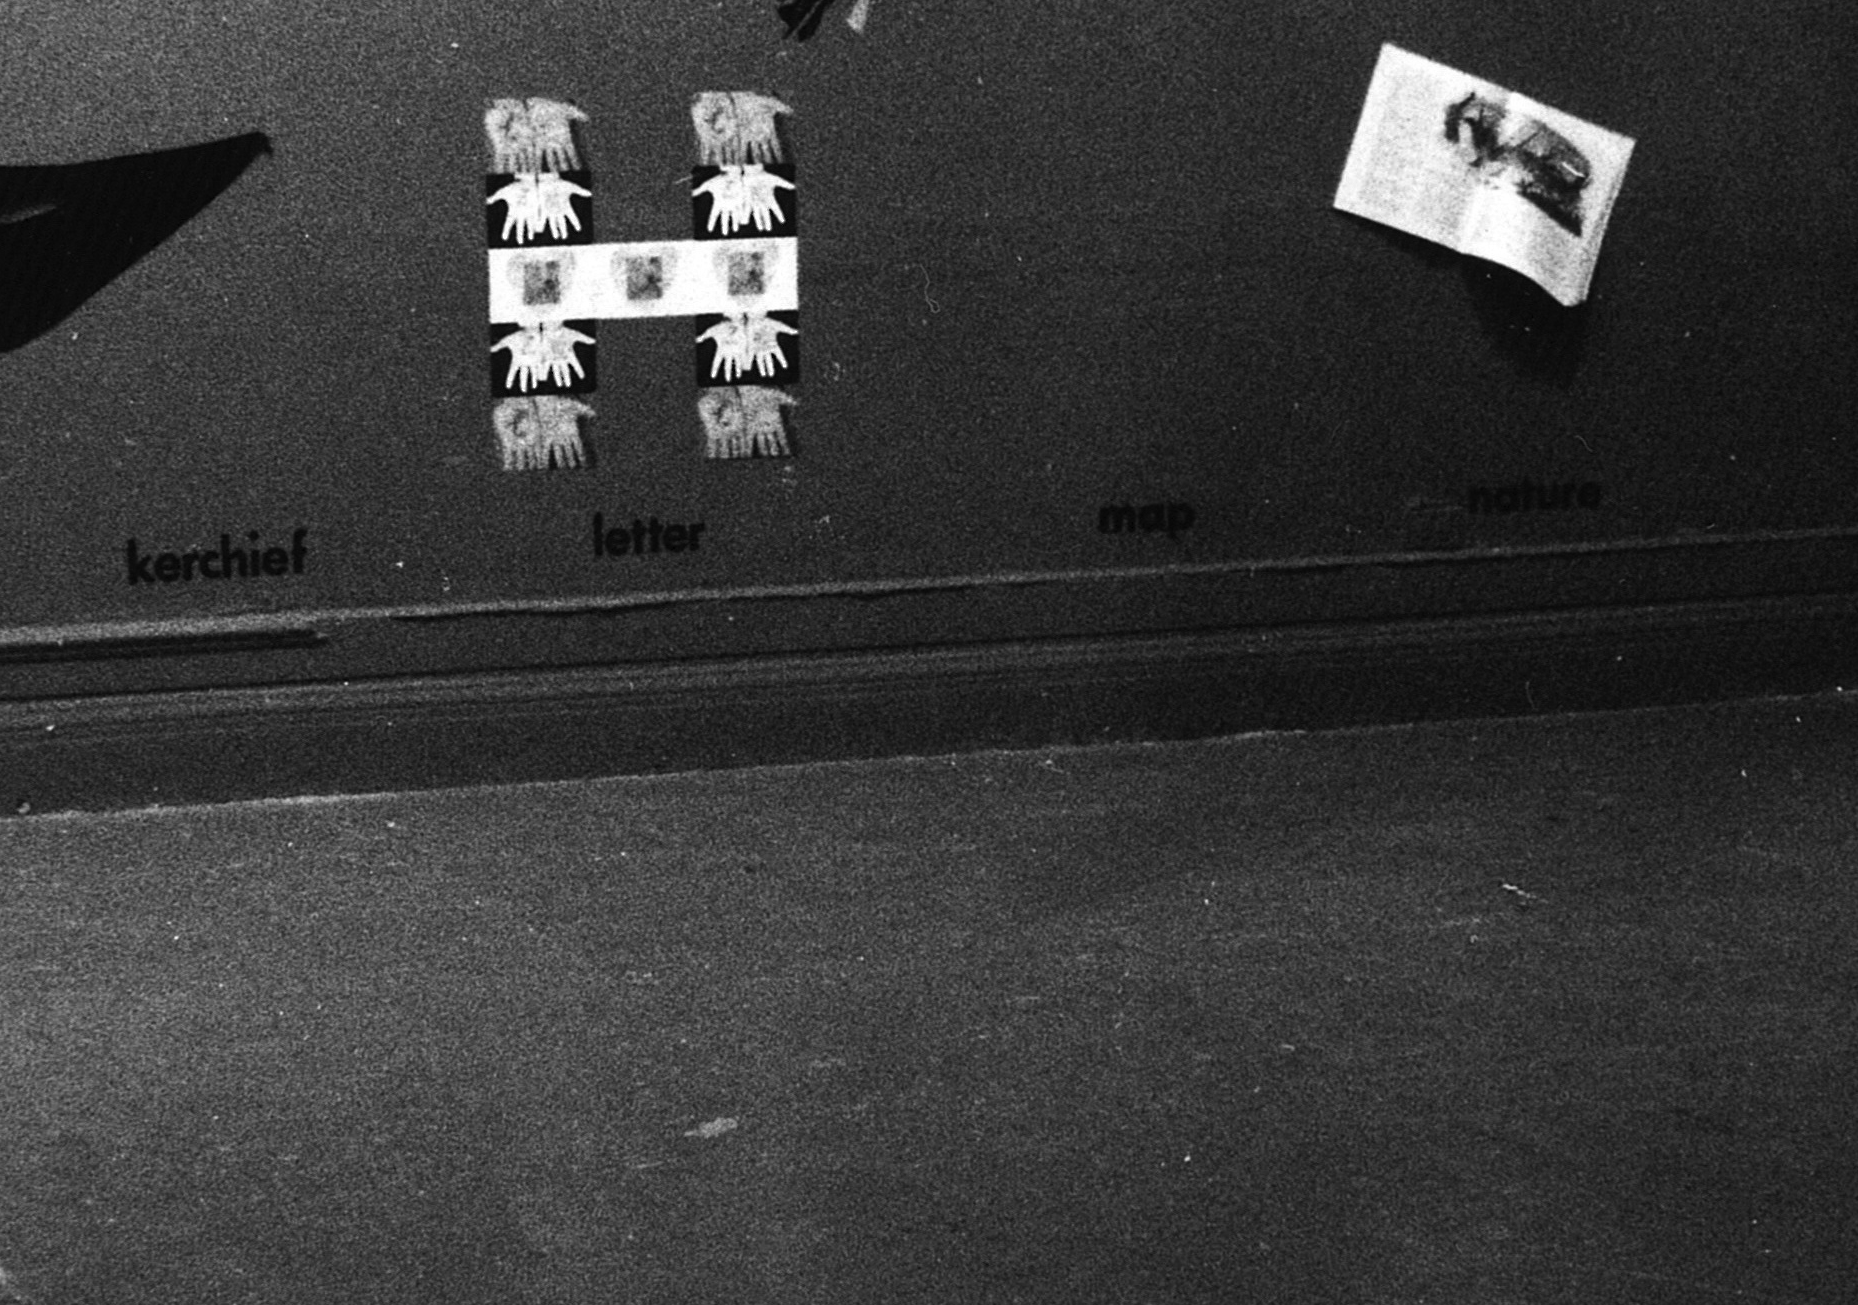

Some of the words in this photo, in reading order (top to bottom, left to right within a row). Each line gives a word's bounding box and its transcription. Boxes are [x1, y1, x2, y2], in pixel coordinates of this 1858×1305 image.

[1098, 497, 1195, 539] map
[1469, 477, 1602, 514] nature
[126, 529, 307, 585] kerchief
[593, 514, 706, 557] letter
